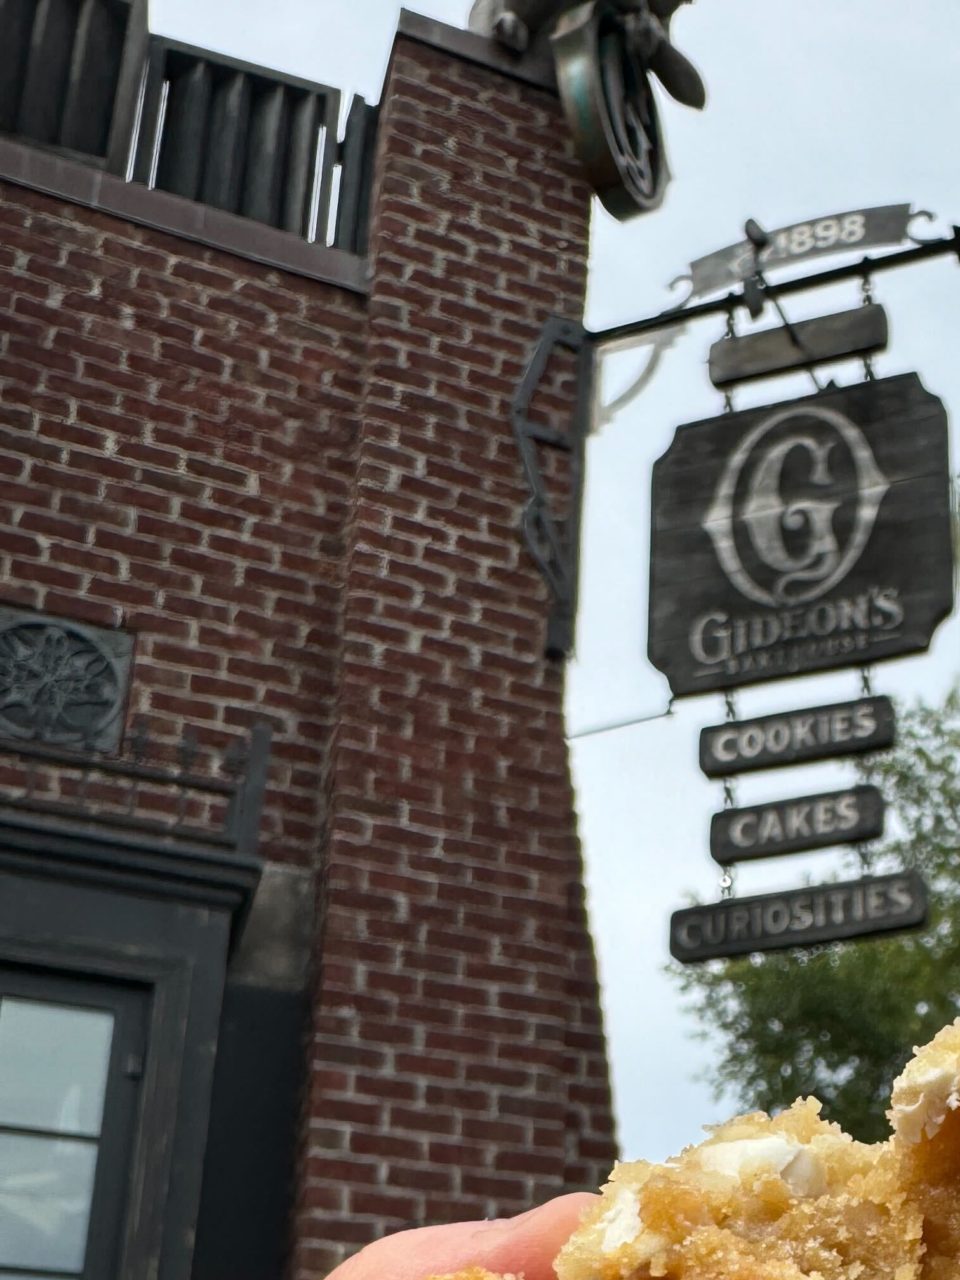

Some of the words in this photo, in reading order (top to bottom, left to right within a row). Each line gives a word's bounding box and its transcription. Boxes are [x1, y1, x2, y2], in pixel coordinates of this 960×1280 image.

[776, 214, 866, 258] 1898
[688, 587, 904, 665] GIDEON'S
[711, 704, 878, 762] COOKIES
[728, 794, 860, 848] CAKES
[677, 877, 913, 948] CURIOSITIES
